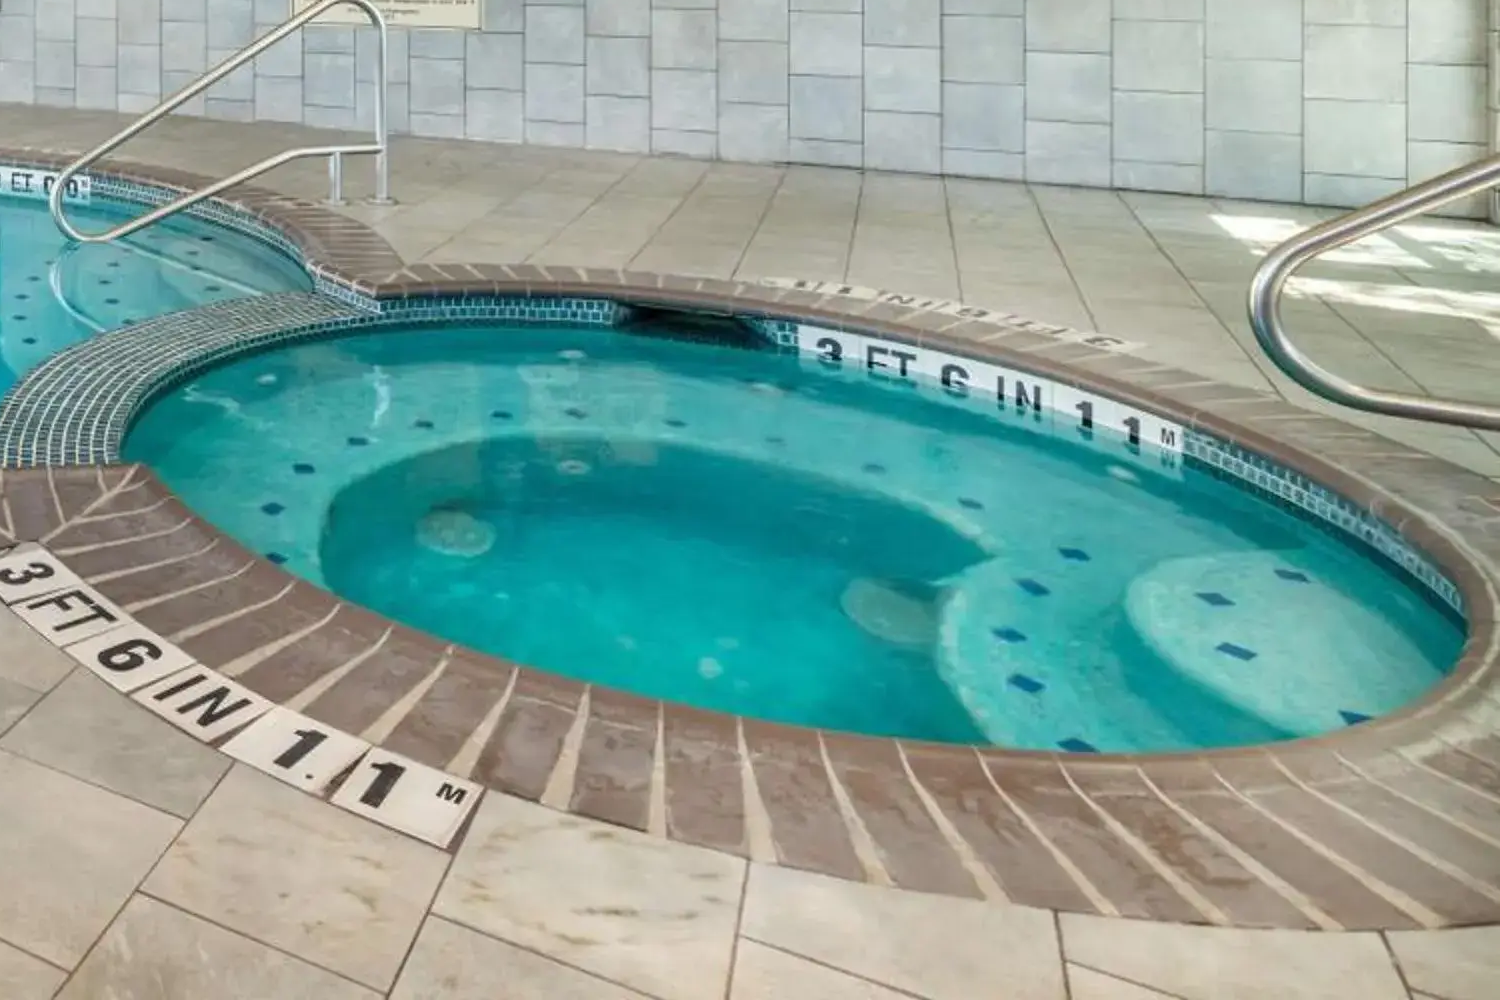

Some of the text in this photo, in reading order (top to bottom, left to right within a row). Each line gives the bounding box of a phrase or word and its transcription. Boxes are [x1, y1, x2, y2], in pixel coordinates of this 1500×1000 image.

[25, 587, 118, 633] FT
[97, 637, 164, 672] 6
[152, 673, 255, 728] IN
[434, 782, 469, 805] M
